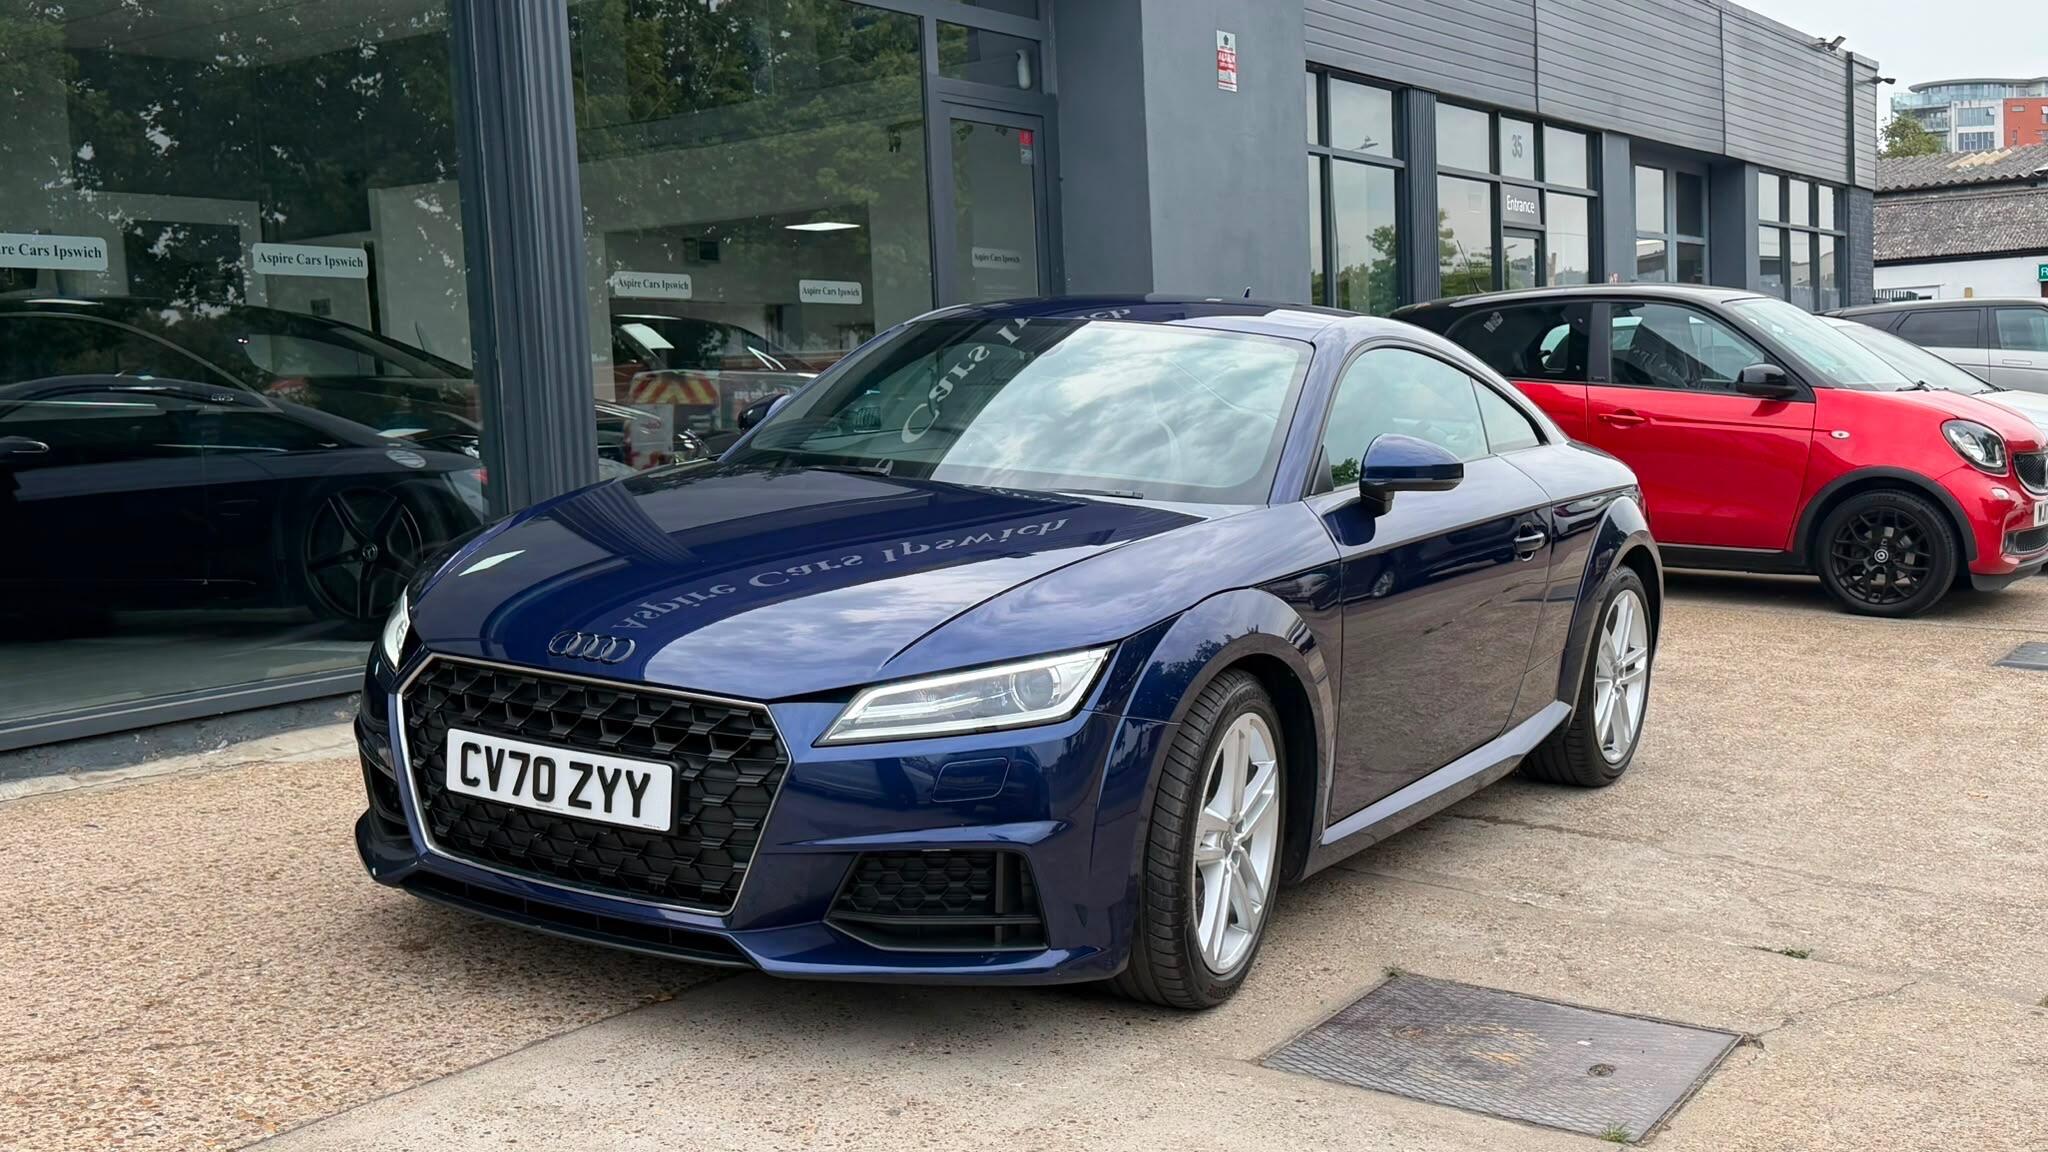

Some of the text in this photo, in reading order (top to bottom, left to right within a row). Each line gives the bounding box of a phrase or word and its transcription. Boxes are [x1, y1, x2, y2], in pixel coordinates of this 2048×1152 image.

[1511, 134, 1524, 159] 35
[1506, 194, 1535, 214] Entrance
[18, 243, 50, 257] Cars
[53, 244, 102, 260] Ipswich
[258, 251, 363, 269] Aspire Cars Ipswich
[618, 277, 689, 292] Aspire Cars Ipswich
[460, 741, 652, 818] CV70 ZYY
